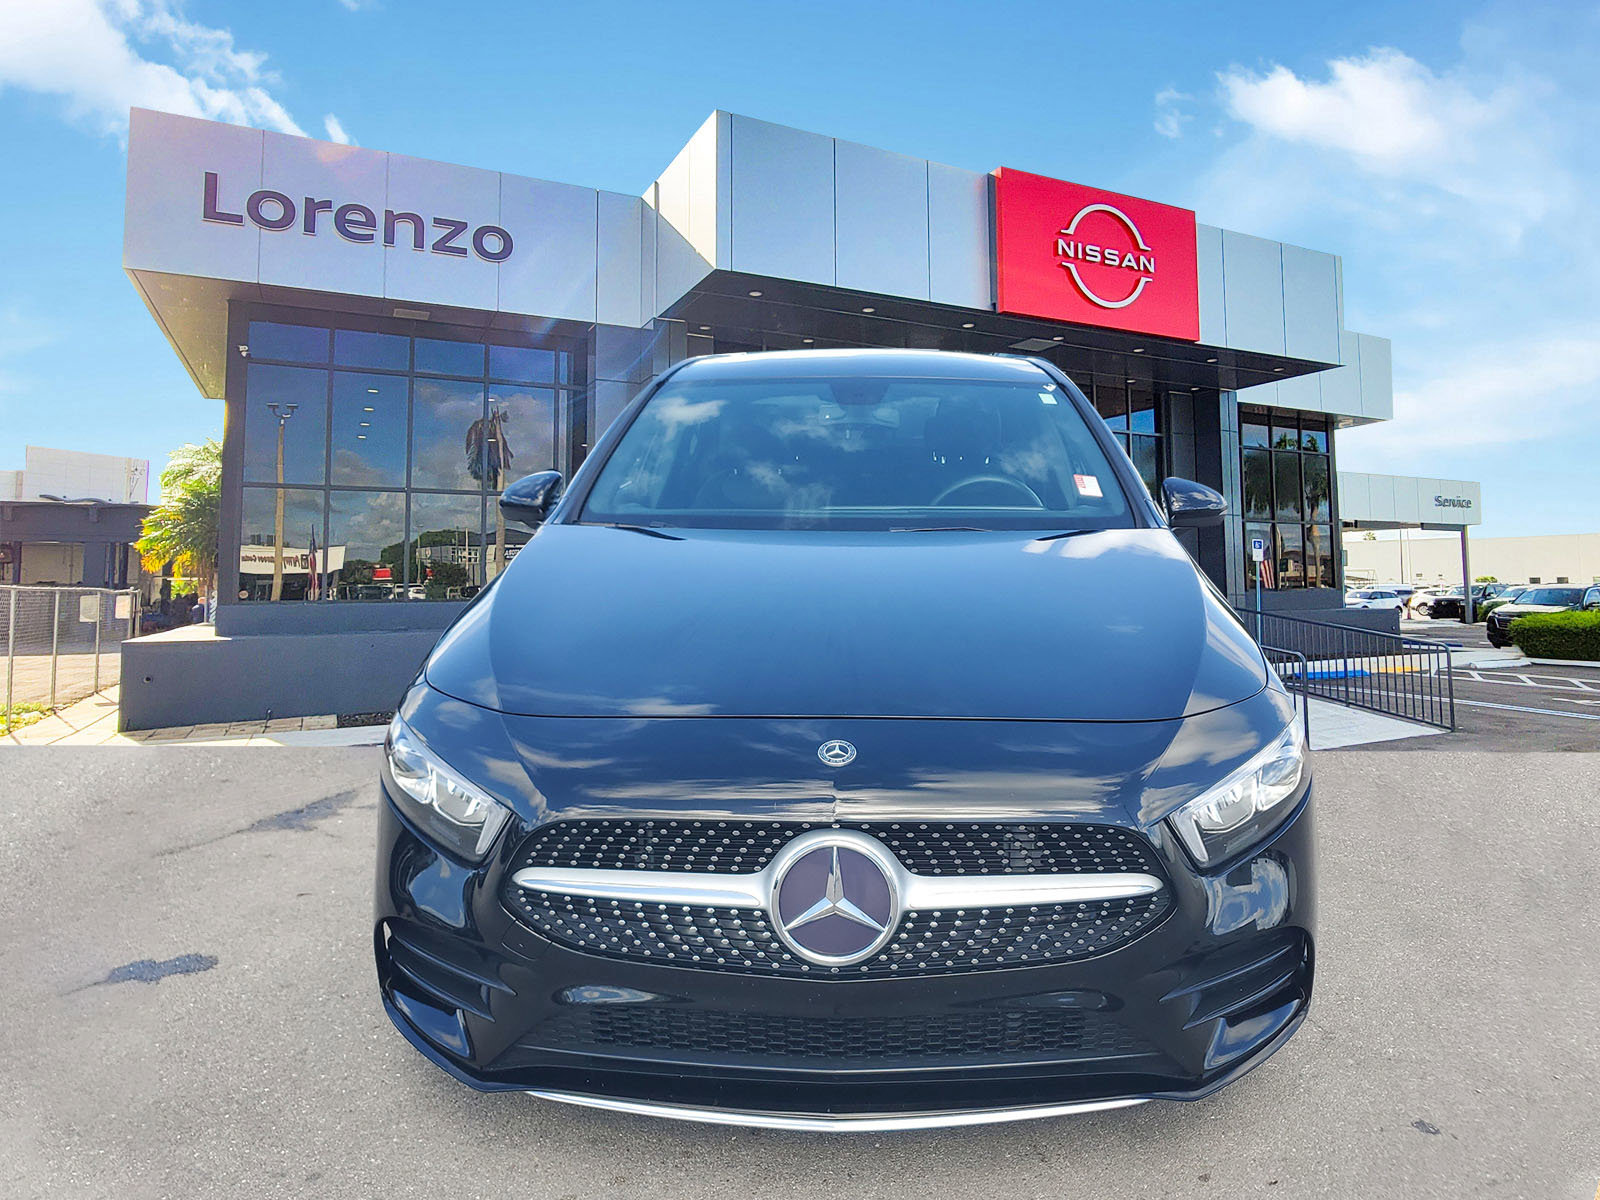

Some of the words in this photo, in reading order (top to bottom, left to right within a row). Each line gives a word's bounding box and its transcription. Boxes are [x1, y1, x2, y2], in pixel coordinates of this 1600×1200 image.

[202, 171, 514, 263] Lorenzo
[1057, 238, 1156, 273] NISSAN
[1434, 495, 1472, 509] Service
